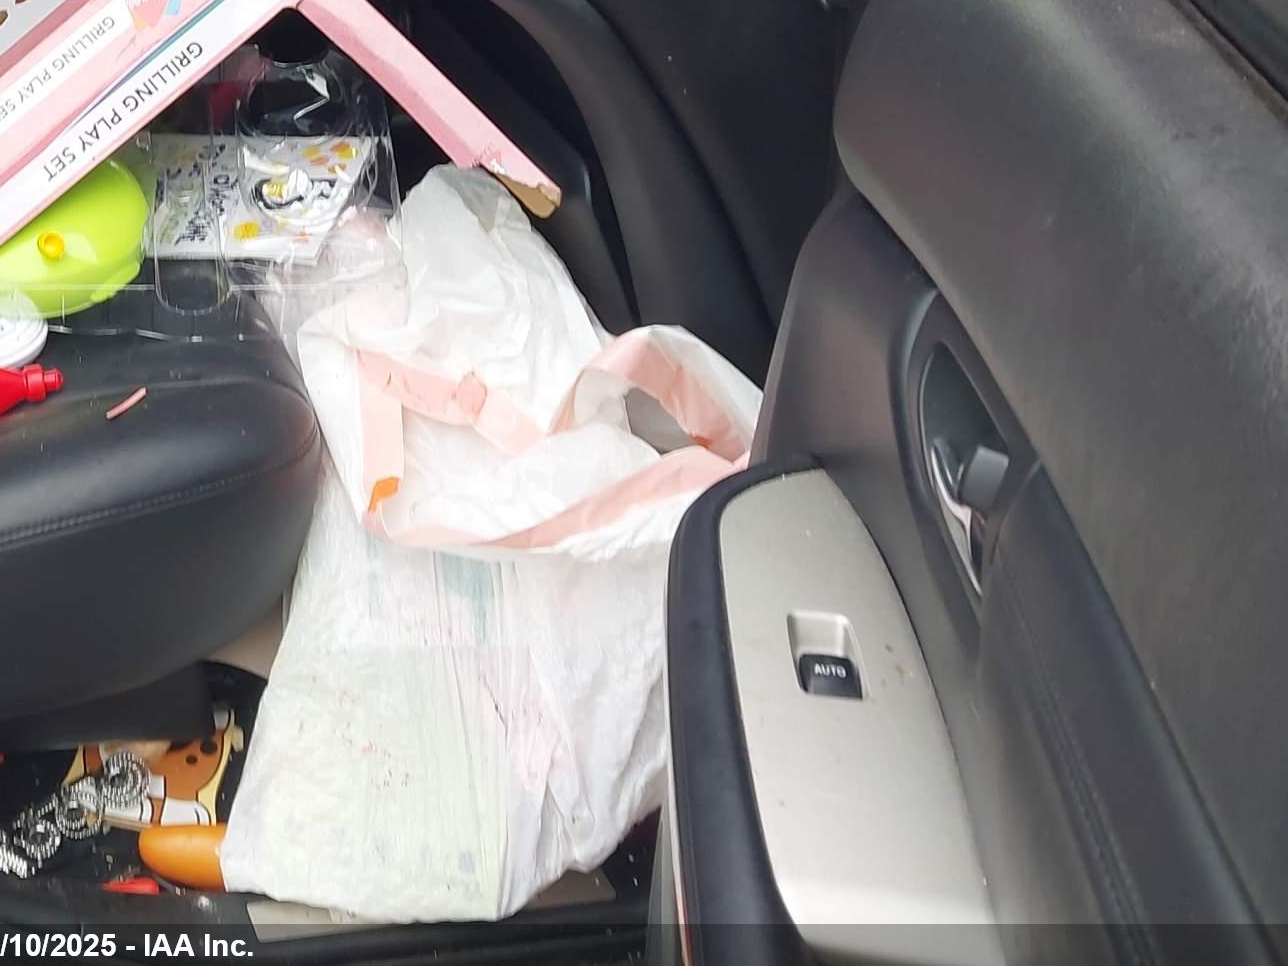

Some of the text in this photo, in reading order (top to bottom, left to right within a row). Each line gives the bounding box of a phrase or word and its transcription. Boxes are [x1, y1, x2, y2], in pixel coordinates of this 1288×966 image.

[52, 16, 115, 71] GRILLING
[18, 71, 52, 104] PLAY
[42, 41, 203, 182] GRILLING PLAY SET
[813, 663, 847, 679] AUTO
